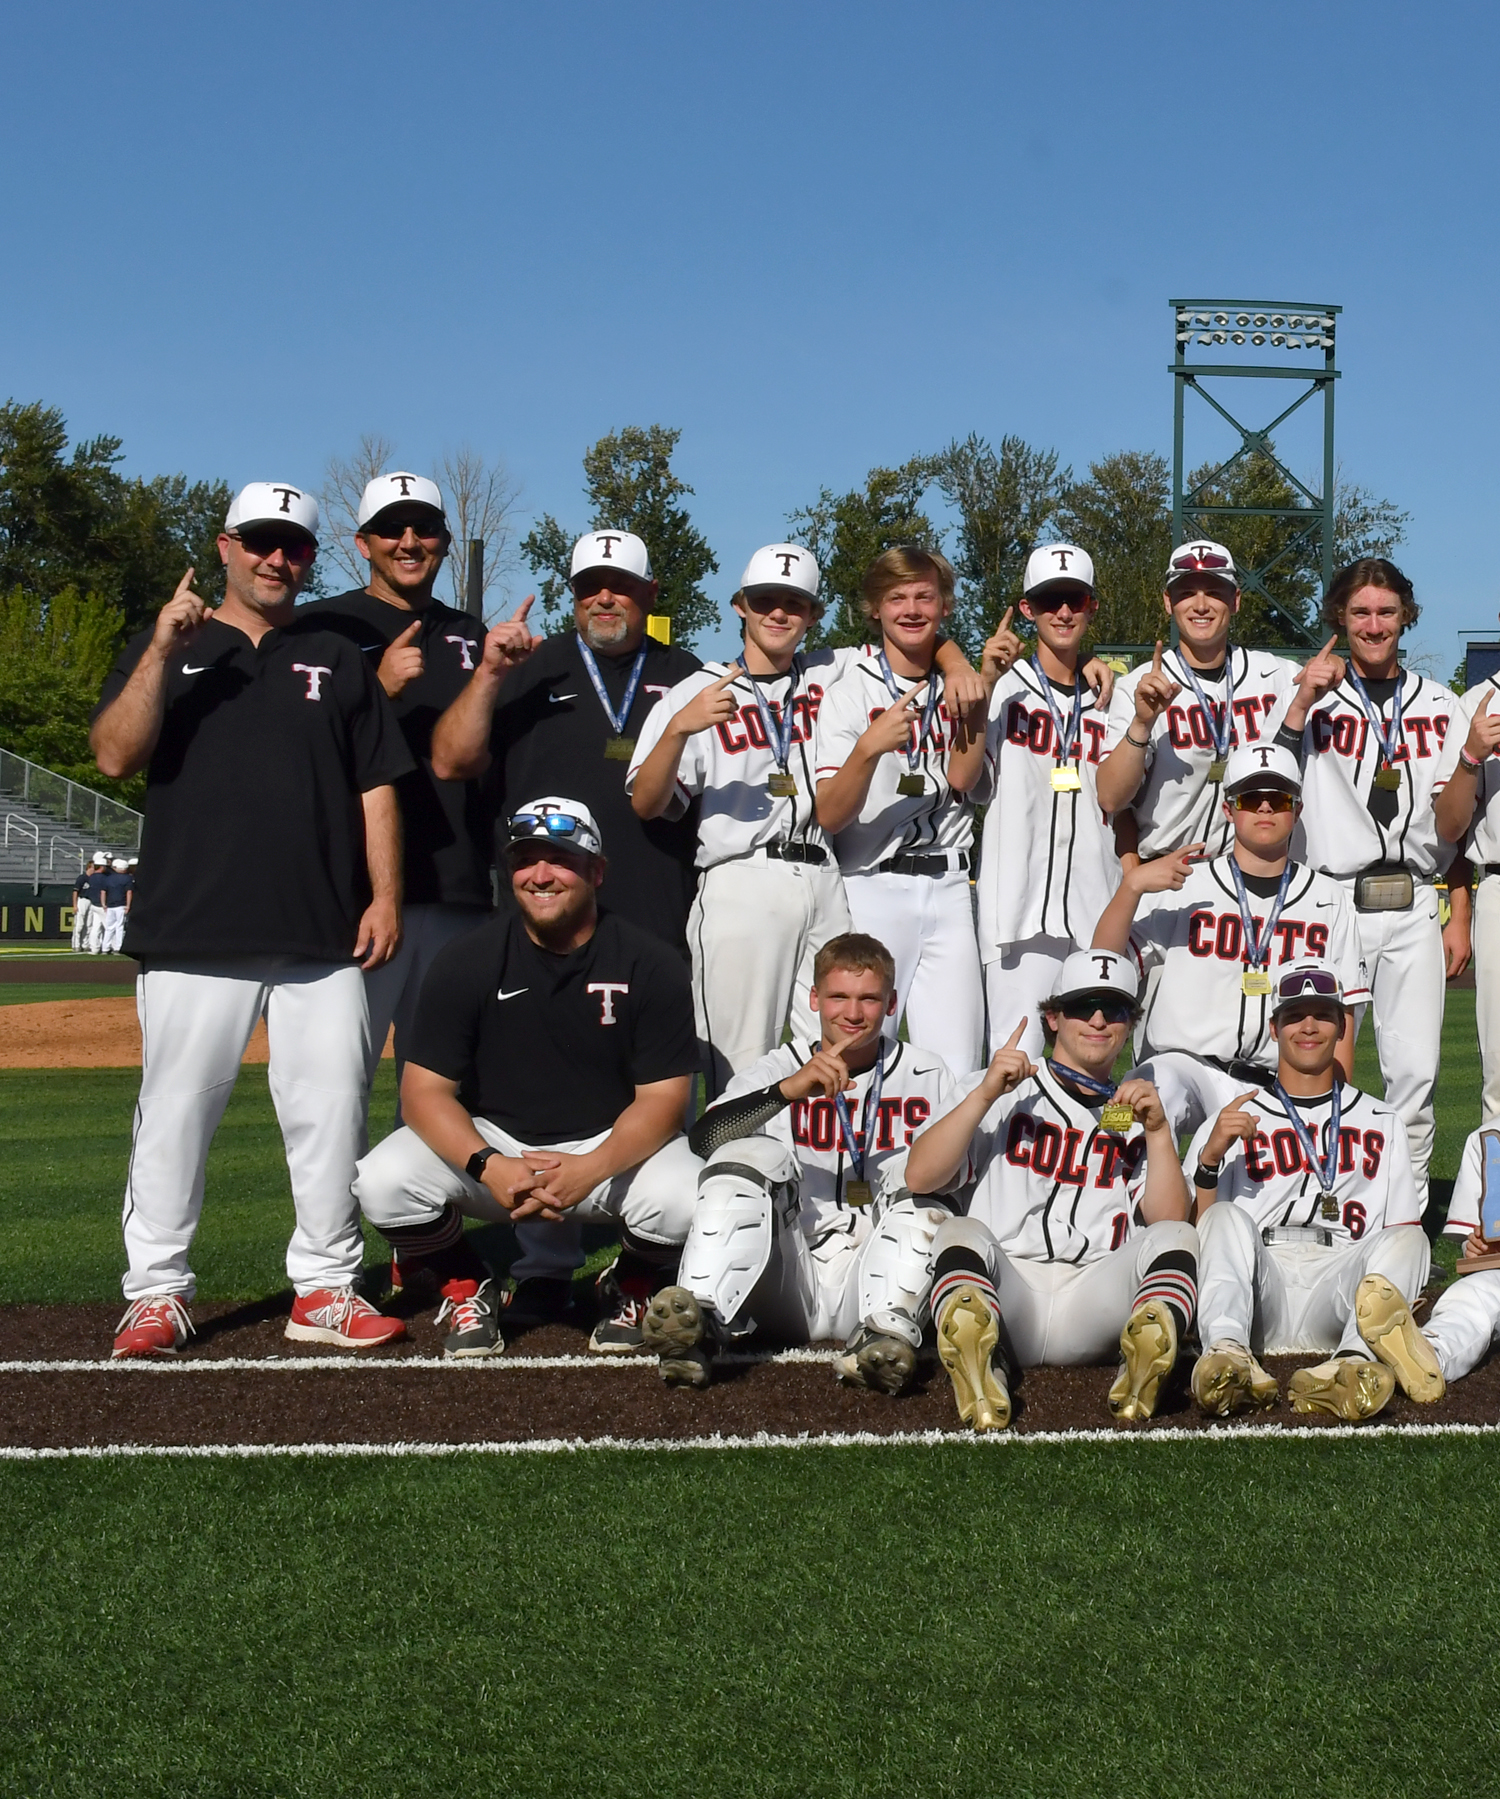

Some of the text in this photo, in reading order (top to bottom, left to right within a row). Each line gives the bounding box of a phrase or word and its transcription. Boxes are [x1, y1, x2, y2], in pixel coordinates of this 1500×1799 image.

[273, 487, 301, 513] T
[390, 475, 417, 496] T
[595, 535, 622, 559] T
[1051, 550, 1074, 572] T
[776, 553, 801, 577] T
[444, 634, 479, 671] T
[291, 662, 333, 702] T
[1251, 746, 1275, 767] T
[1188, 909, 1329, 966] COLTS
[1091, 955, 1119, 980] T
[587, 982, 629, 1026] T
[790, 1096, 931, 1152] COLTS
[1243, 1127, 1386, 1183] COLTS
[1341, 1201, 1367, 1240] 6
